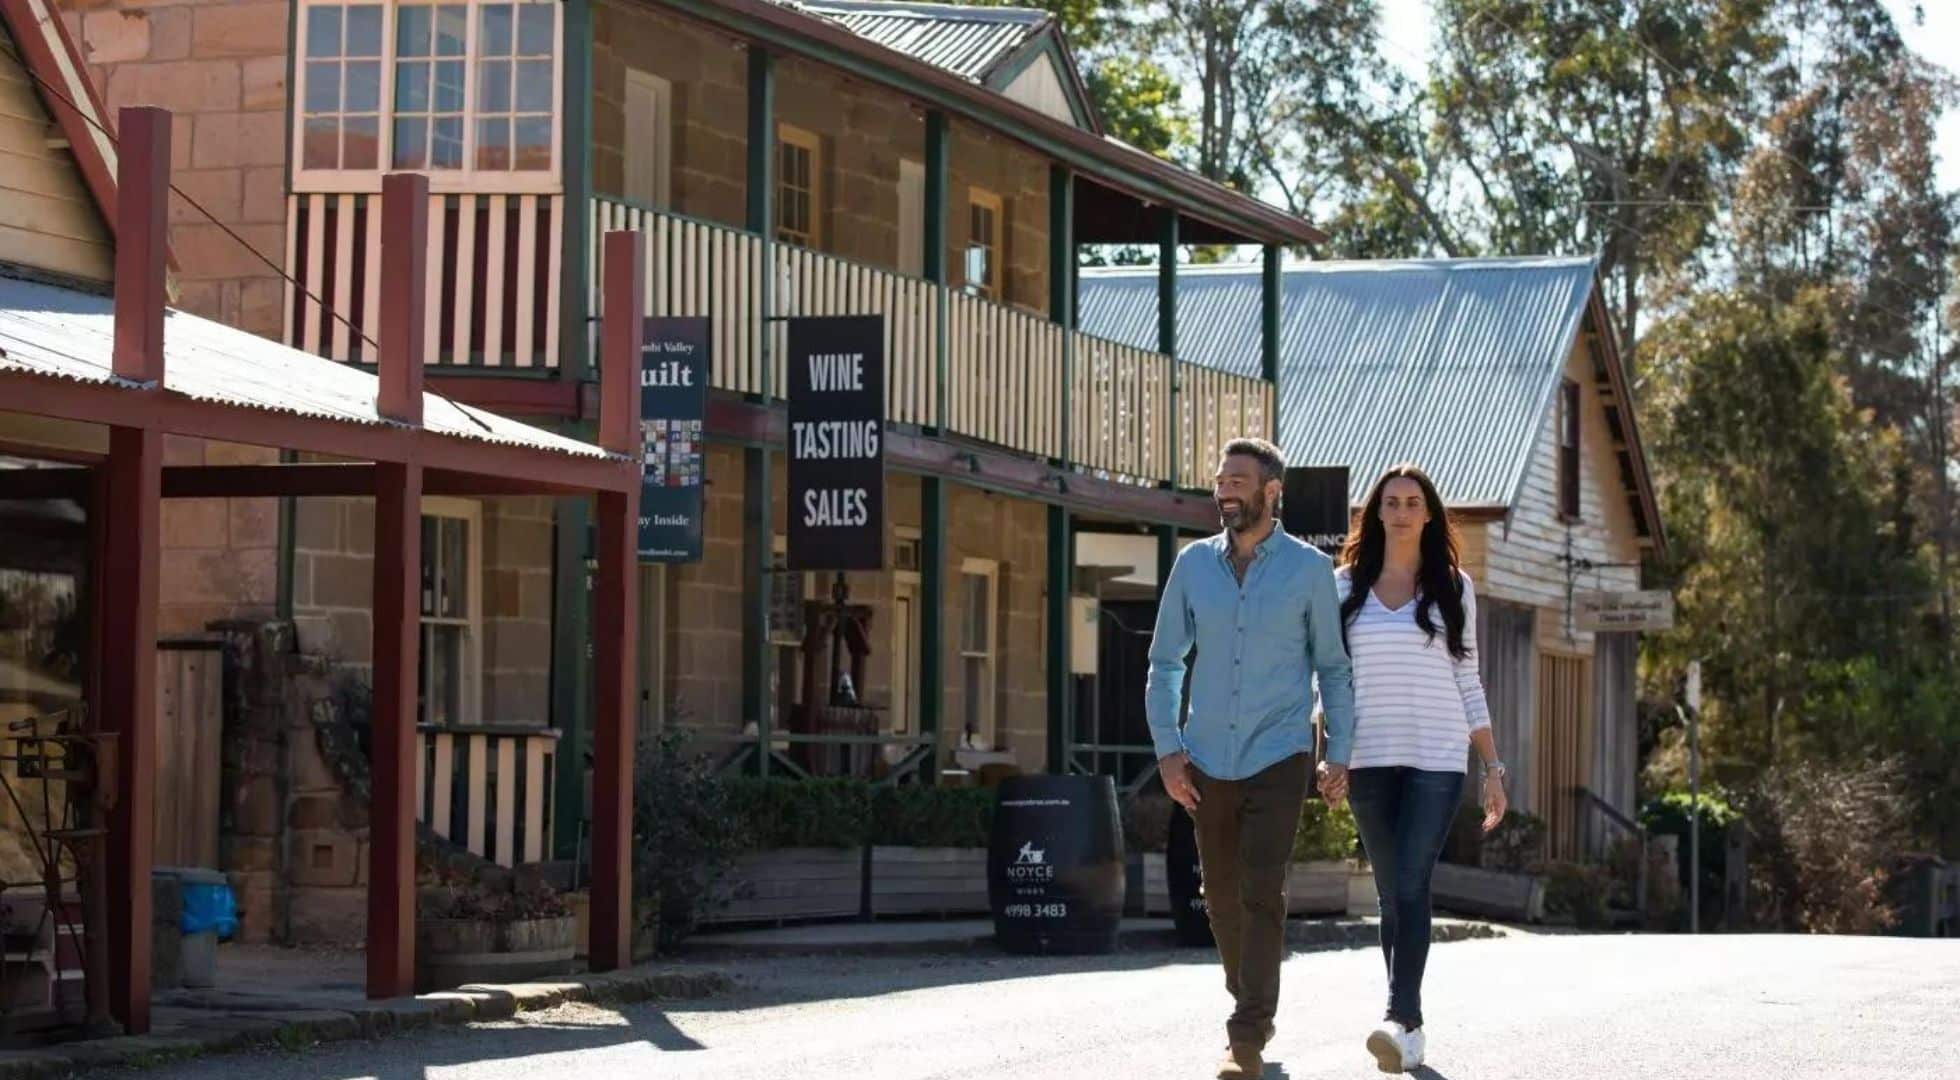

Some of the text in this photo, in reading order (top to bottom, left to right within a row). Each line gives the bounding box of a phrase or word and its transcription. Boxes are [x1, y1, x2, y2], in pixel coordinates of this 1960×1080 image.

[664, 341, 694, 355] Valley
[809, 353, 863, 392] WINE
[792, 420, 878, 459] TASTING
[803, 488, 868, 527] SALES
[654, 514, 689, 526] Inside
[1007, 865, 1054, 878] NOYCE
[1004, 903, 1067, 918] 4998 3483
